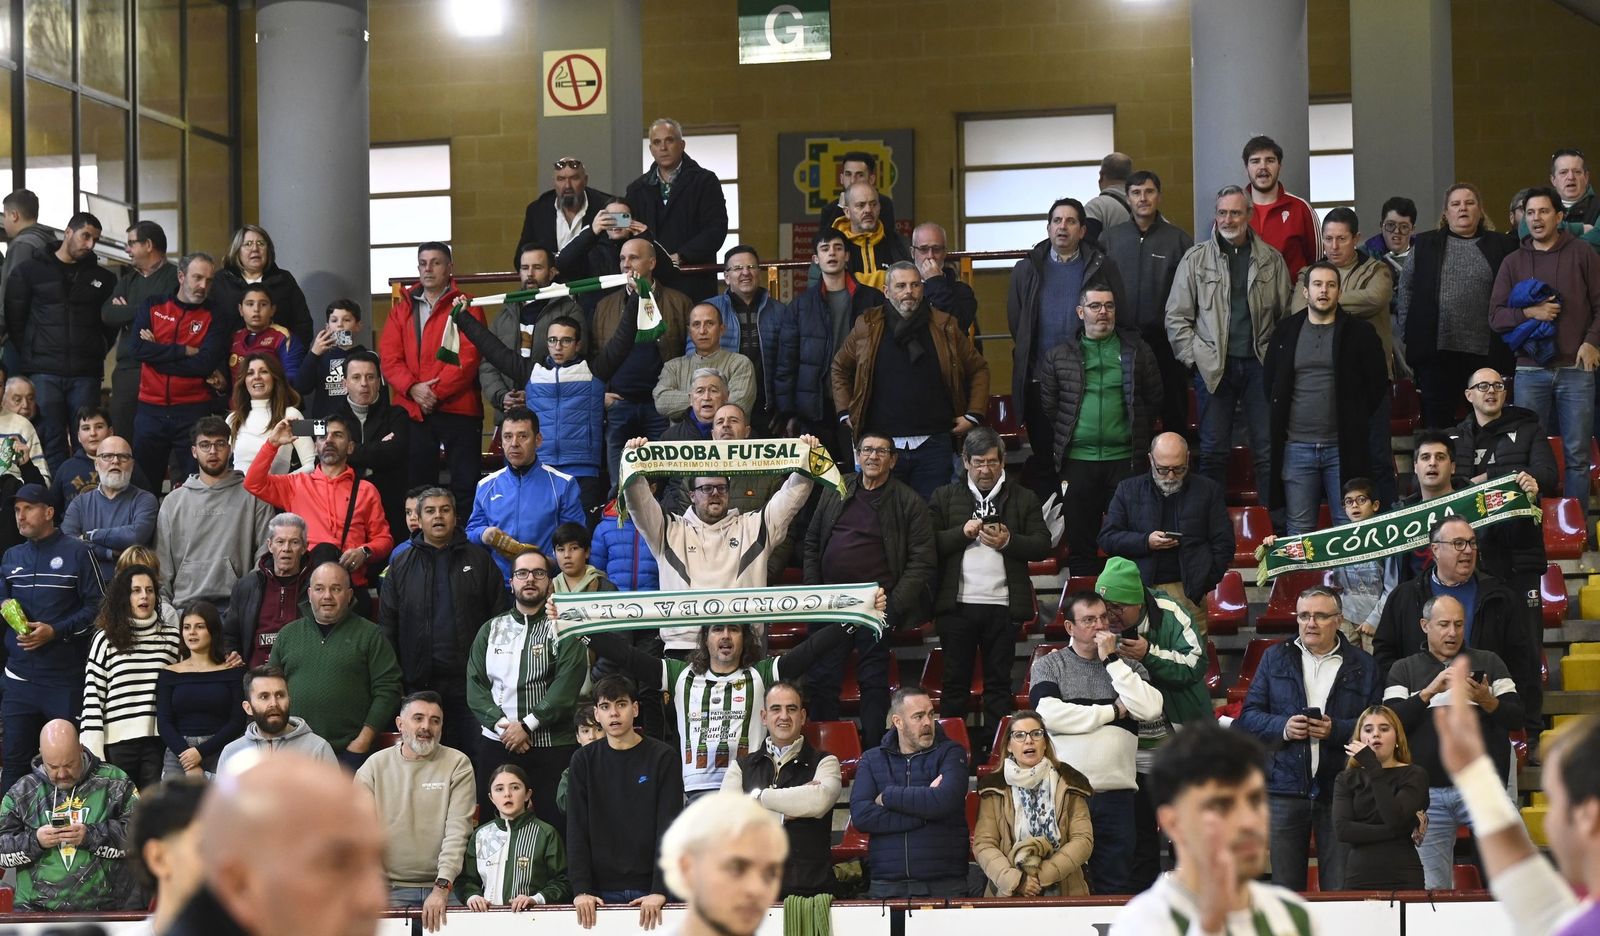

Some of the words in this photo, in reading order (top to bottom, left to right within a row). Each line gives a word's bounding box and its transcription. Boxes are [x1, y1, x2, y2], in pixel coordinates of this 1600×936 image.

[765, 4, 804, 50] G
[728, 443, 800, 460] FUTSAL
[668, 461, 719, 469] PATRIMONIO
[752, 459, 800, 467] HUMANIDAD
[654, 594, 822, 618] CORDOBA
